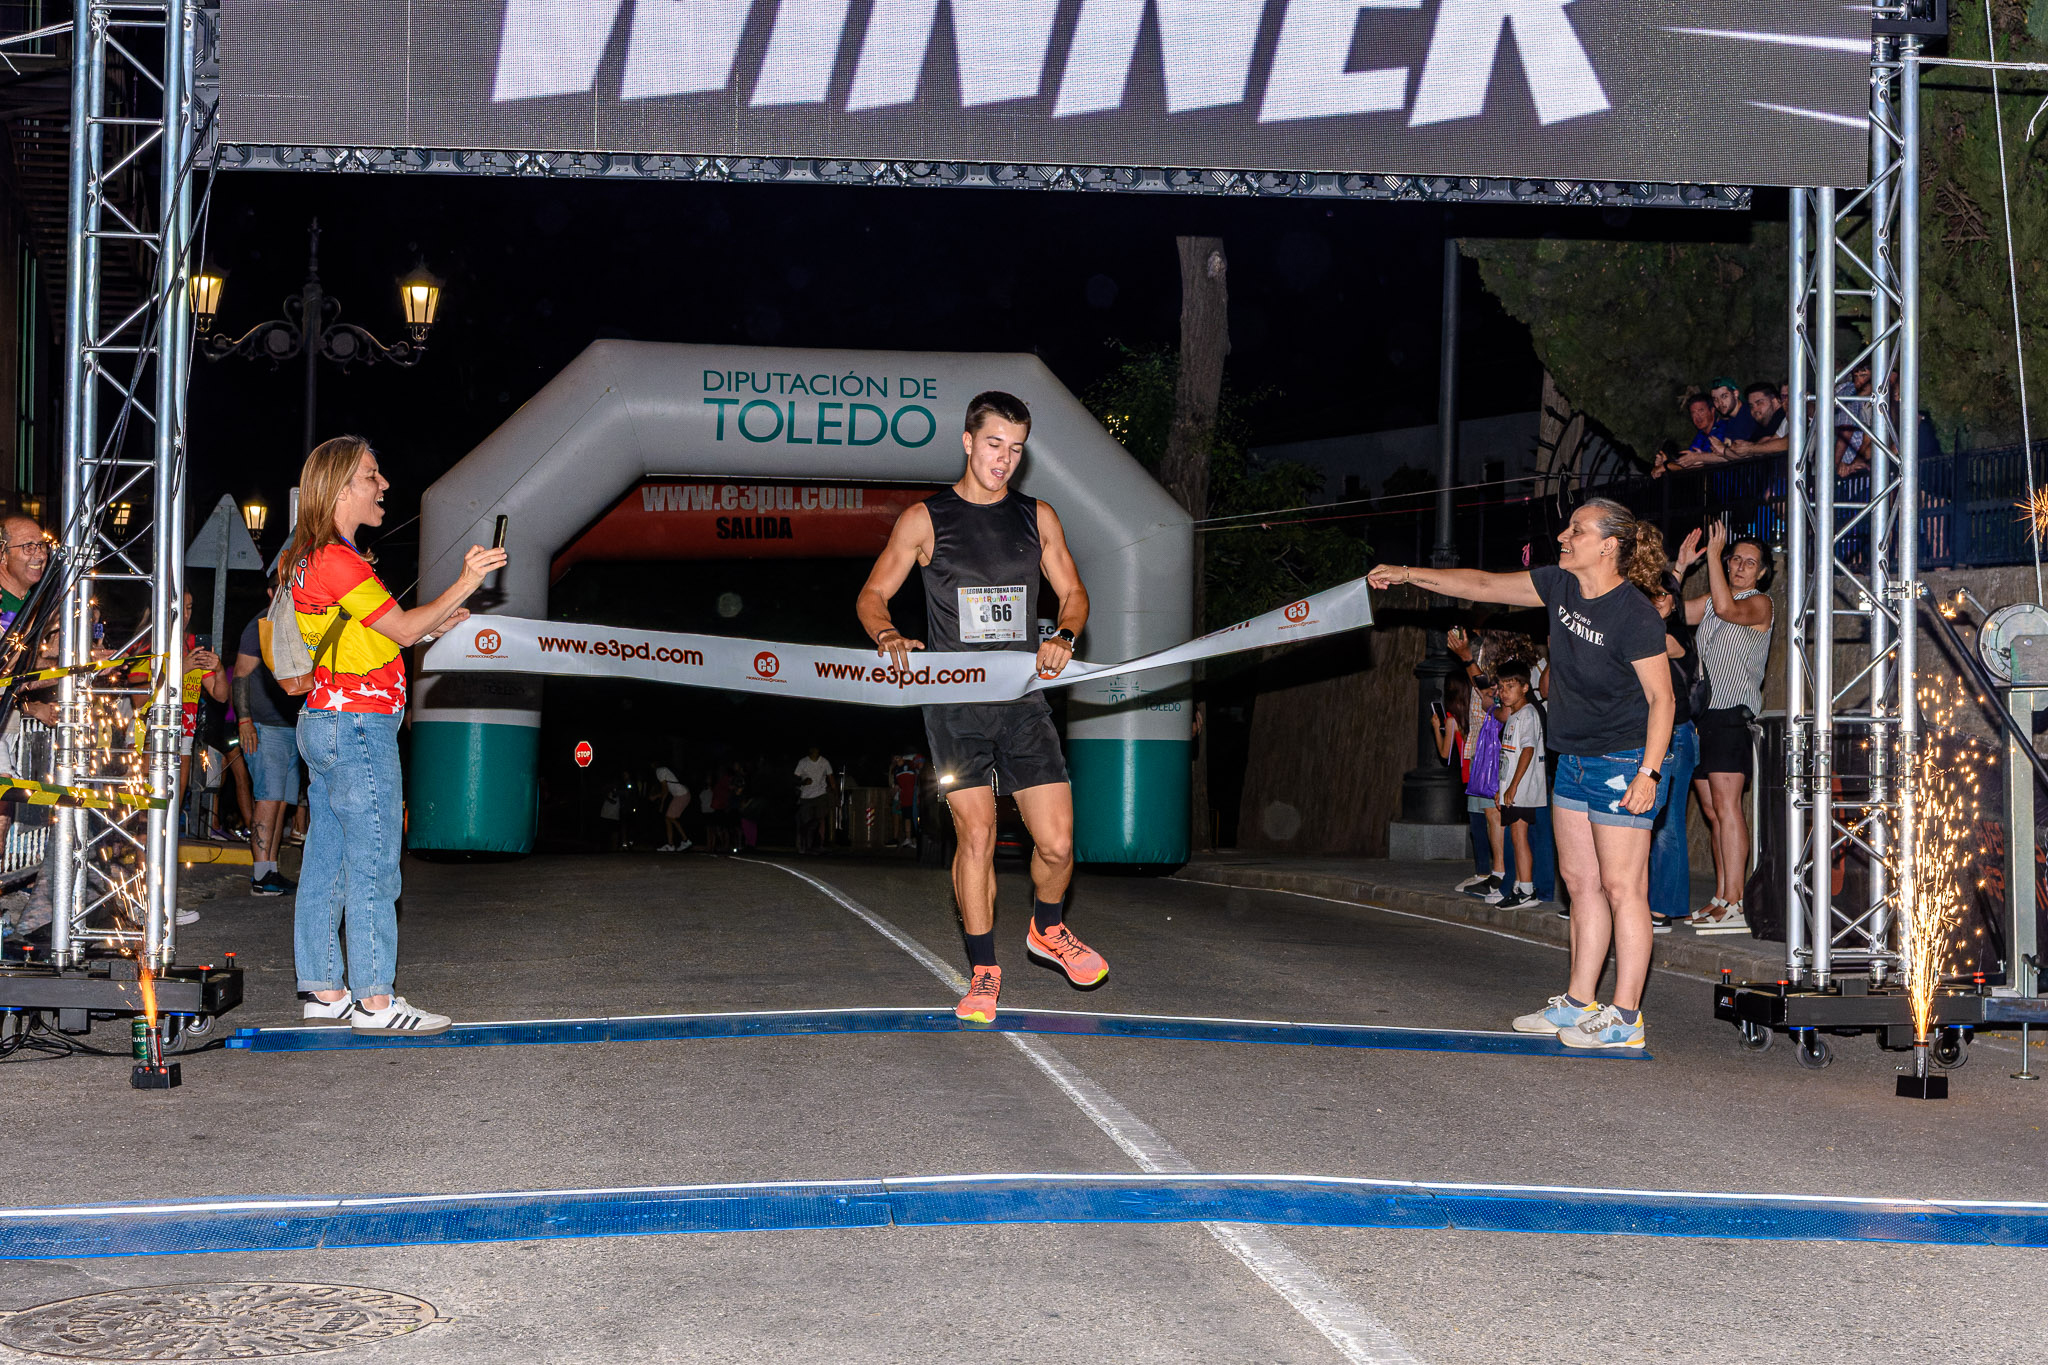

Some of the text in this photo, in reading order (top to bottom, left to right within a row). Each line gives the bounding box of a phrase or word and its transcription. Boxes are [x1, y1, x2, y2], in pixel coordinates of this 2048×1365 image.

[703, 370, 937, 399] DIPUTACIÓN DE
[703, 397, 937, 448] TOLEDO
[641, 485, 864, 514] www.e3pd.com
[716, 516, 793, 540] SALIDA
[979, 603, 1012, 623] 366
[478, 633, 499, 651] e3
[537, 636, 704, 666] www.e3pd.com
[757, 656, 777, 673] e3
[814, 661, 986, 689] www.e3pd.com
